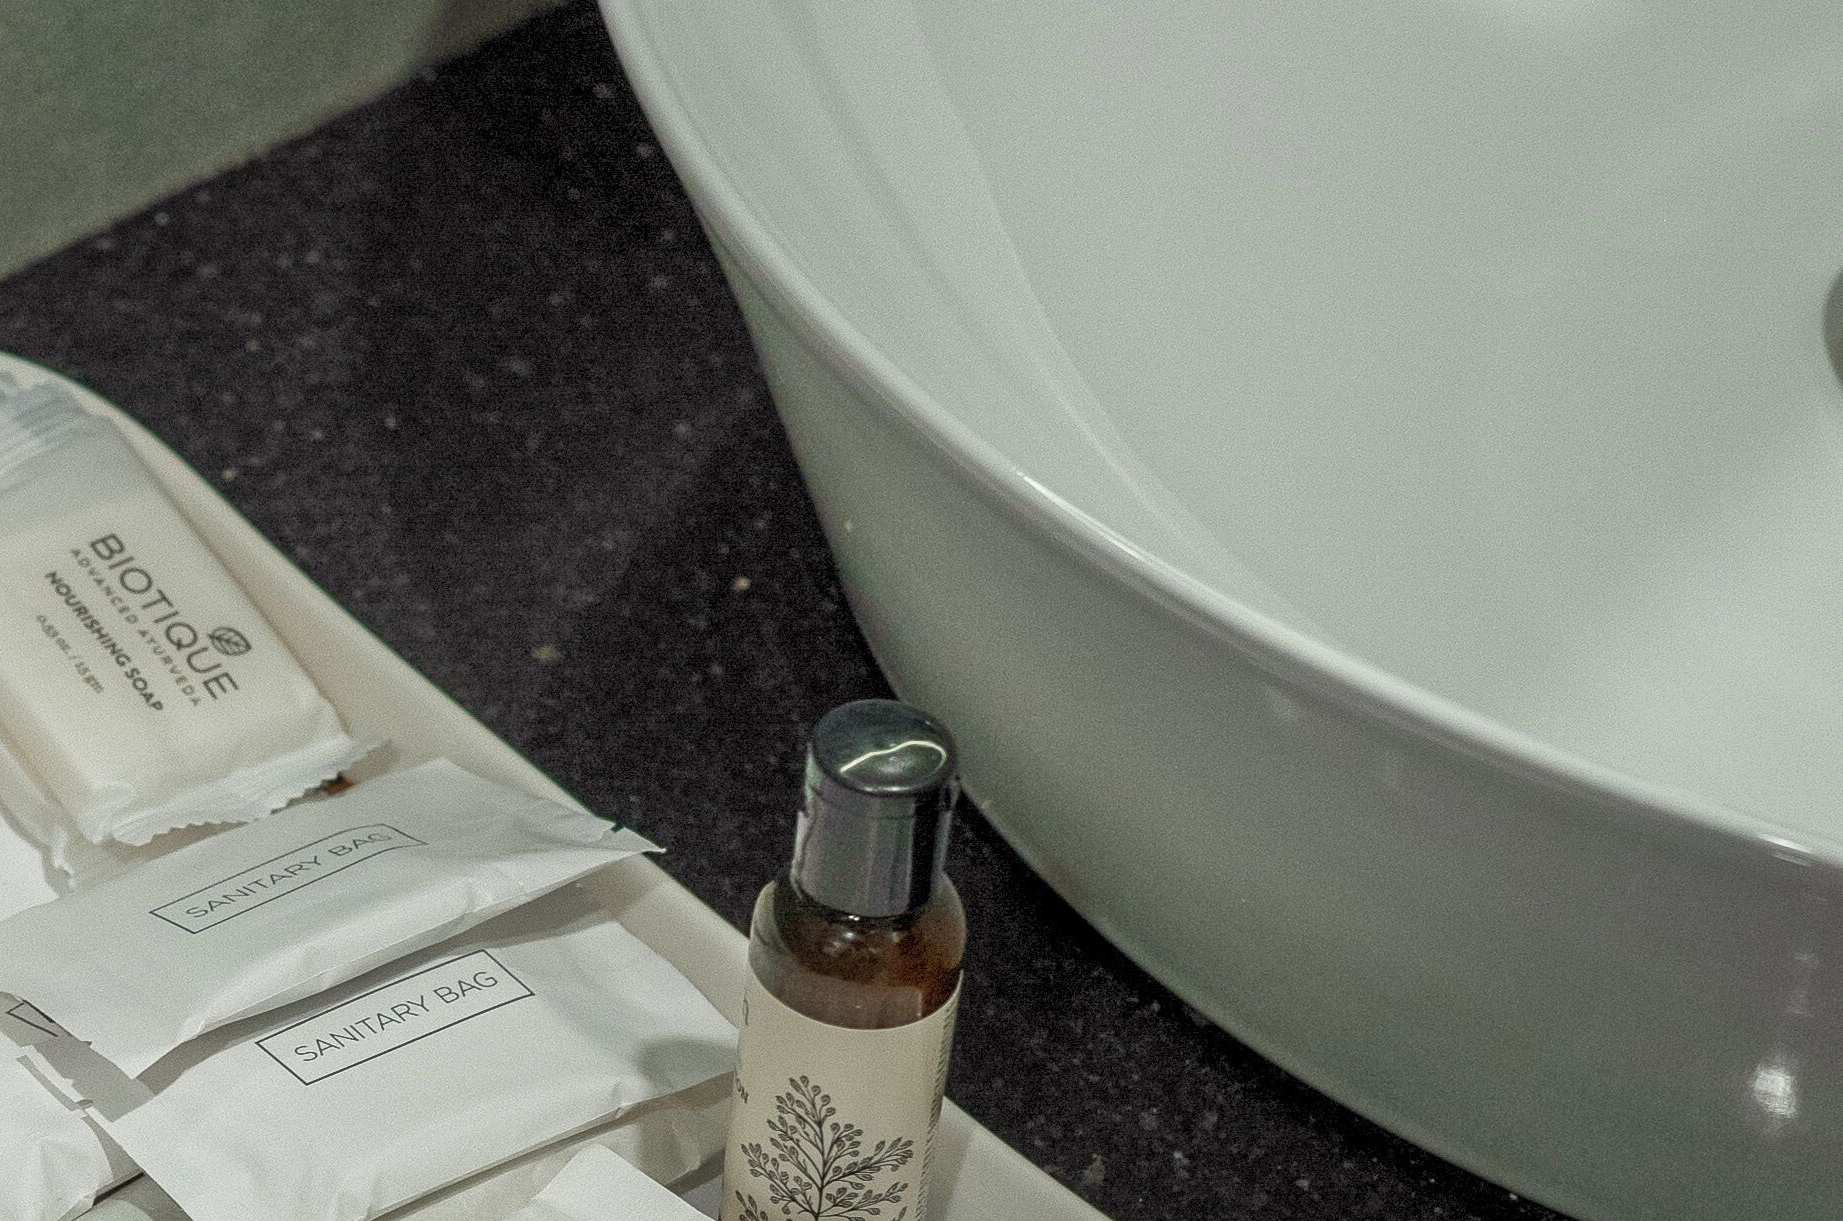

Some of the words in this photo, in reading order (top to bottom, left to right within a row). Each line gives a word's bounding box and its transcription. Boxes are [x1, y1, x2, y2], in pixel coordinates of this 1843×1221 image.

[45, 571, 131, 667] NOURISHING
[125, 666, 163, 711] SOAP
[71, 549, 139, 625] ADVANCED
[137, 628, 201, 706] AYURVEDA
[90, 533, 239, 700] BIOTIQUE
[186, 855, 321, 918] SANITARY
[328, 833, 392, 857] BAG
[294, 995, 429, 1062] SANITARY
[433, 971, 498, 1004] BAG
